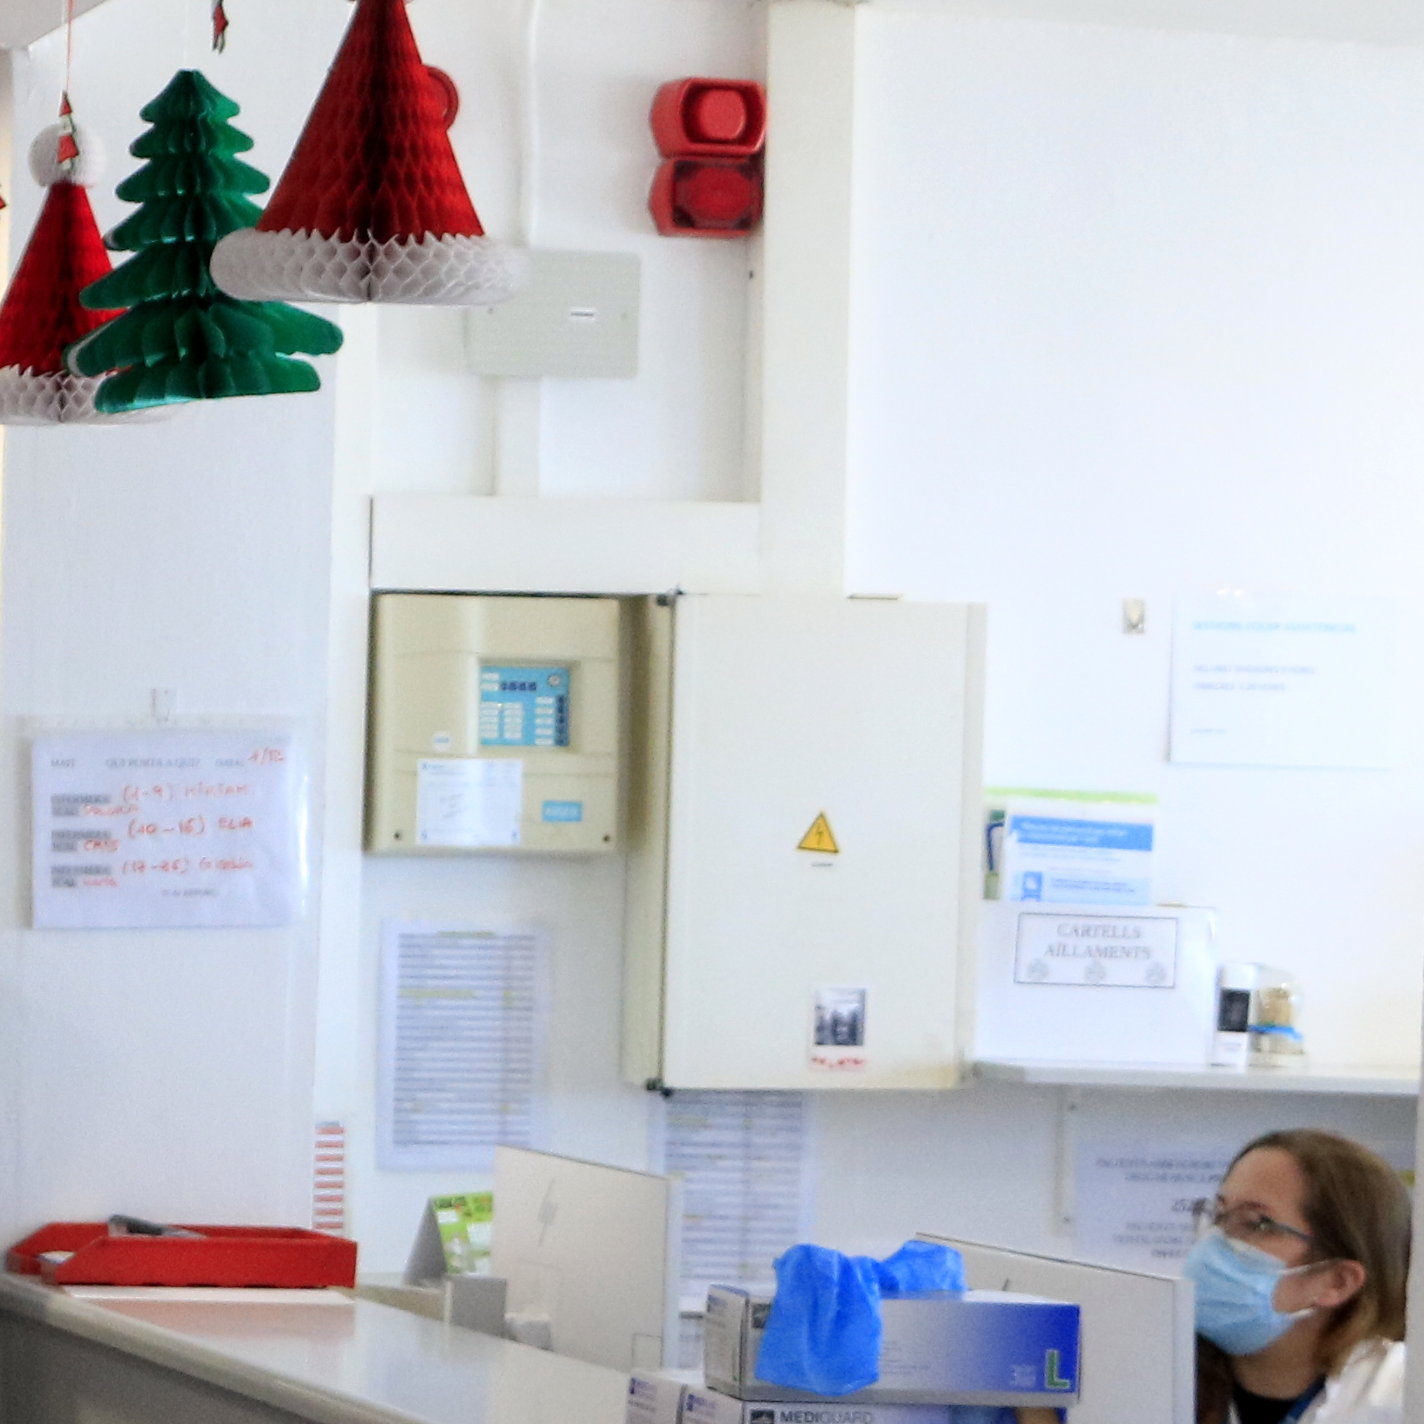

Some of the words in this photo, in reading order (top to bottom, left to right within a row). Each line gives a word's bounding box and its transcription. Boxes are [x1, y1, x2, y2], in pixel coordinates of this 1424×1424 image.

[1056, 922, 1141, 939] CARTELLS
[1045, 1348, 1072, 1390] L
[780, 1410, 874, 1424] MEDIGUARD
